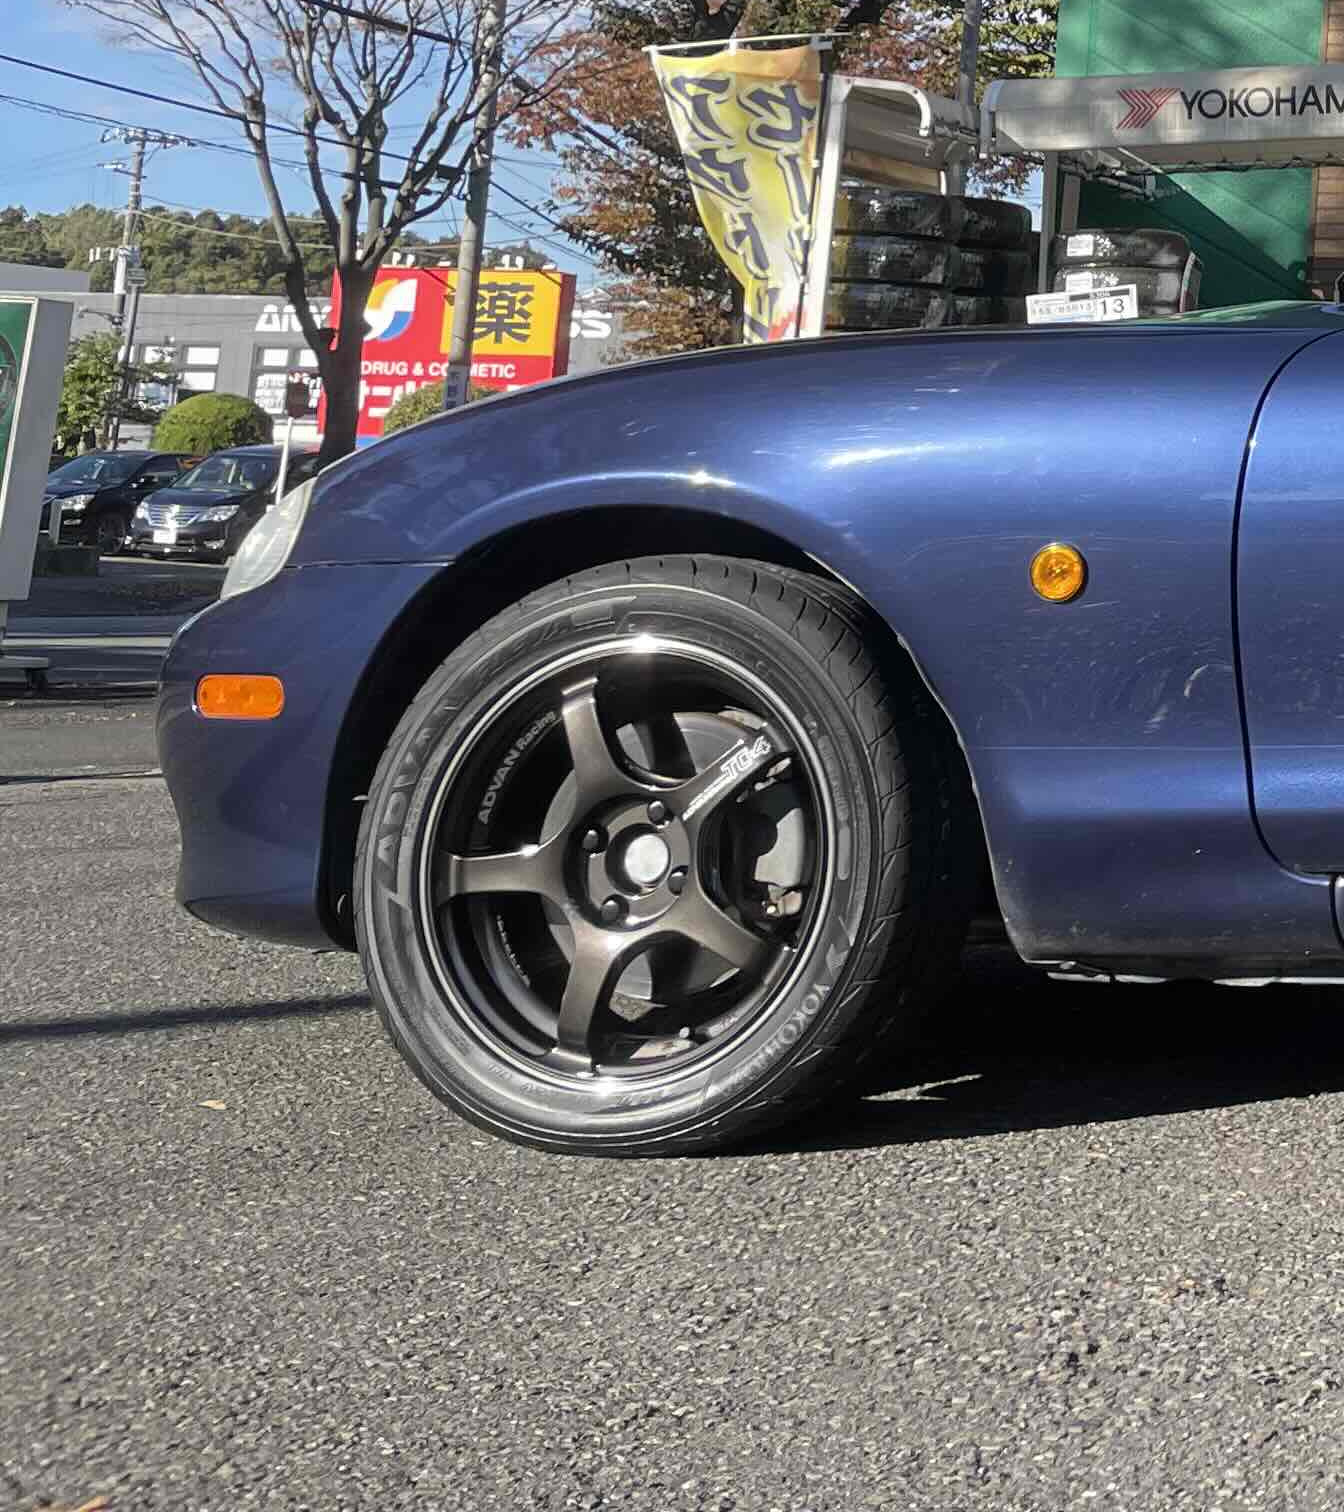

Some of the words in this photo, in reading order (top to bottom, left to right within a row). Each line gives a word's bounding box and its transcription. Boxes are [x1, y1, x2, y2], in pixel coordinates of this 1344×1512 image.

[472, 281, 534, 344] 薬
[1102, 298, 1125, 315] 13
[360, 360, 408, 376] DRUG
[413, 361, 424, 376] &
[428, 363, 515, 378] COMETIC
[477, 748, 521, 825] ADVAN
[514, 710, 557, 751] Racing
